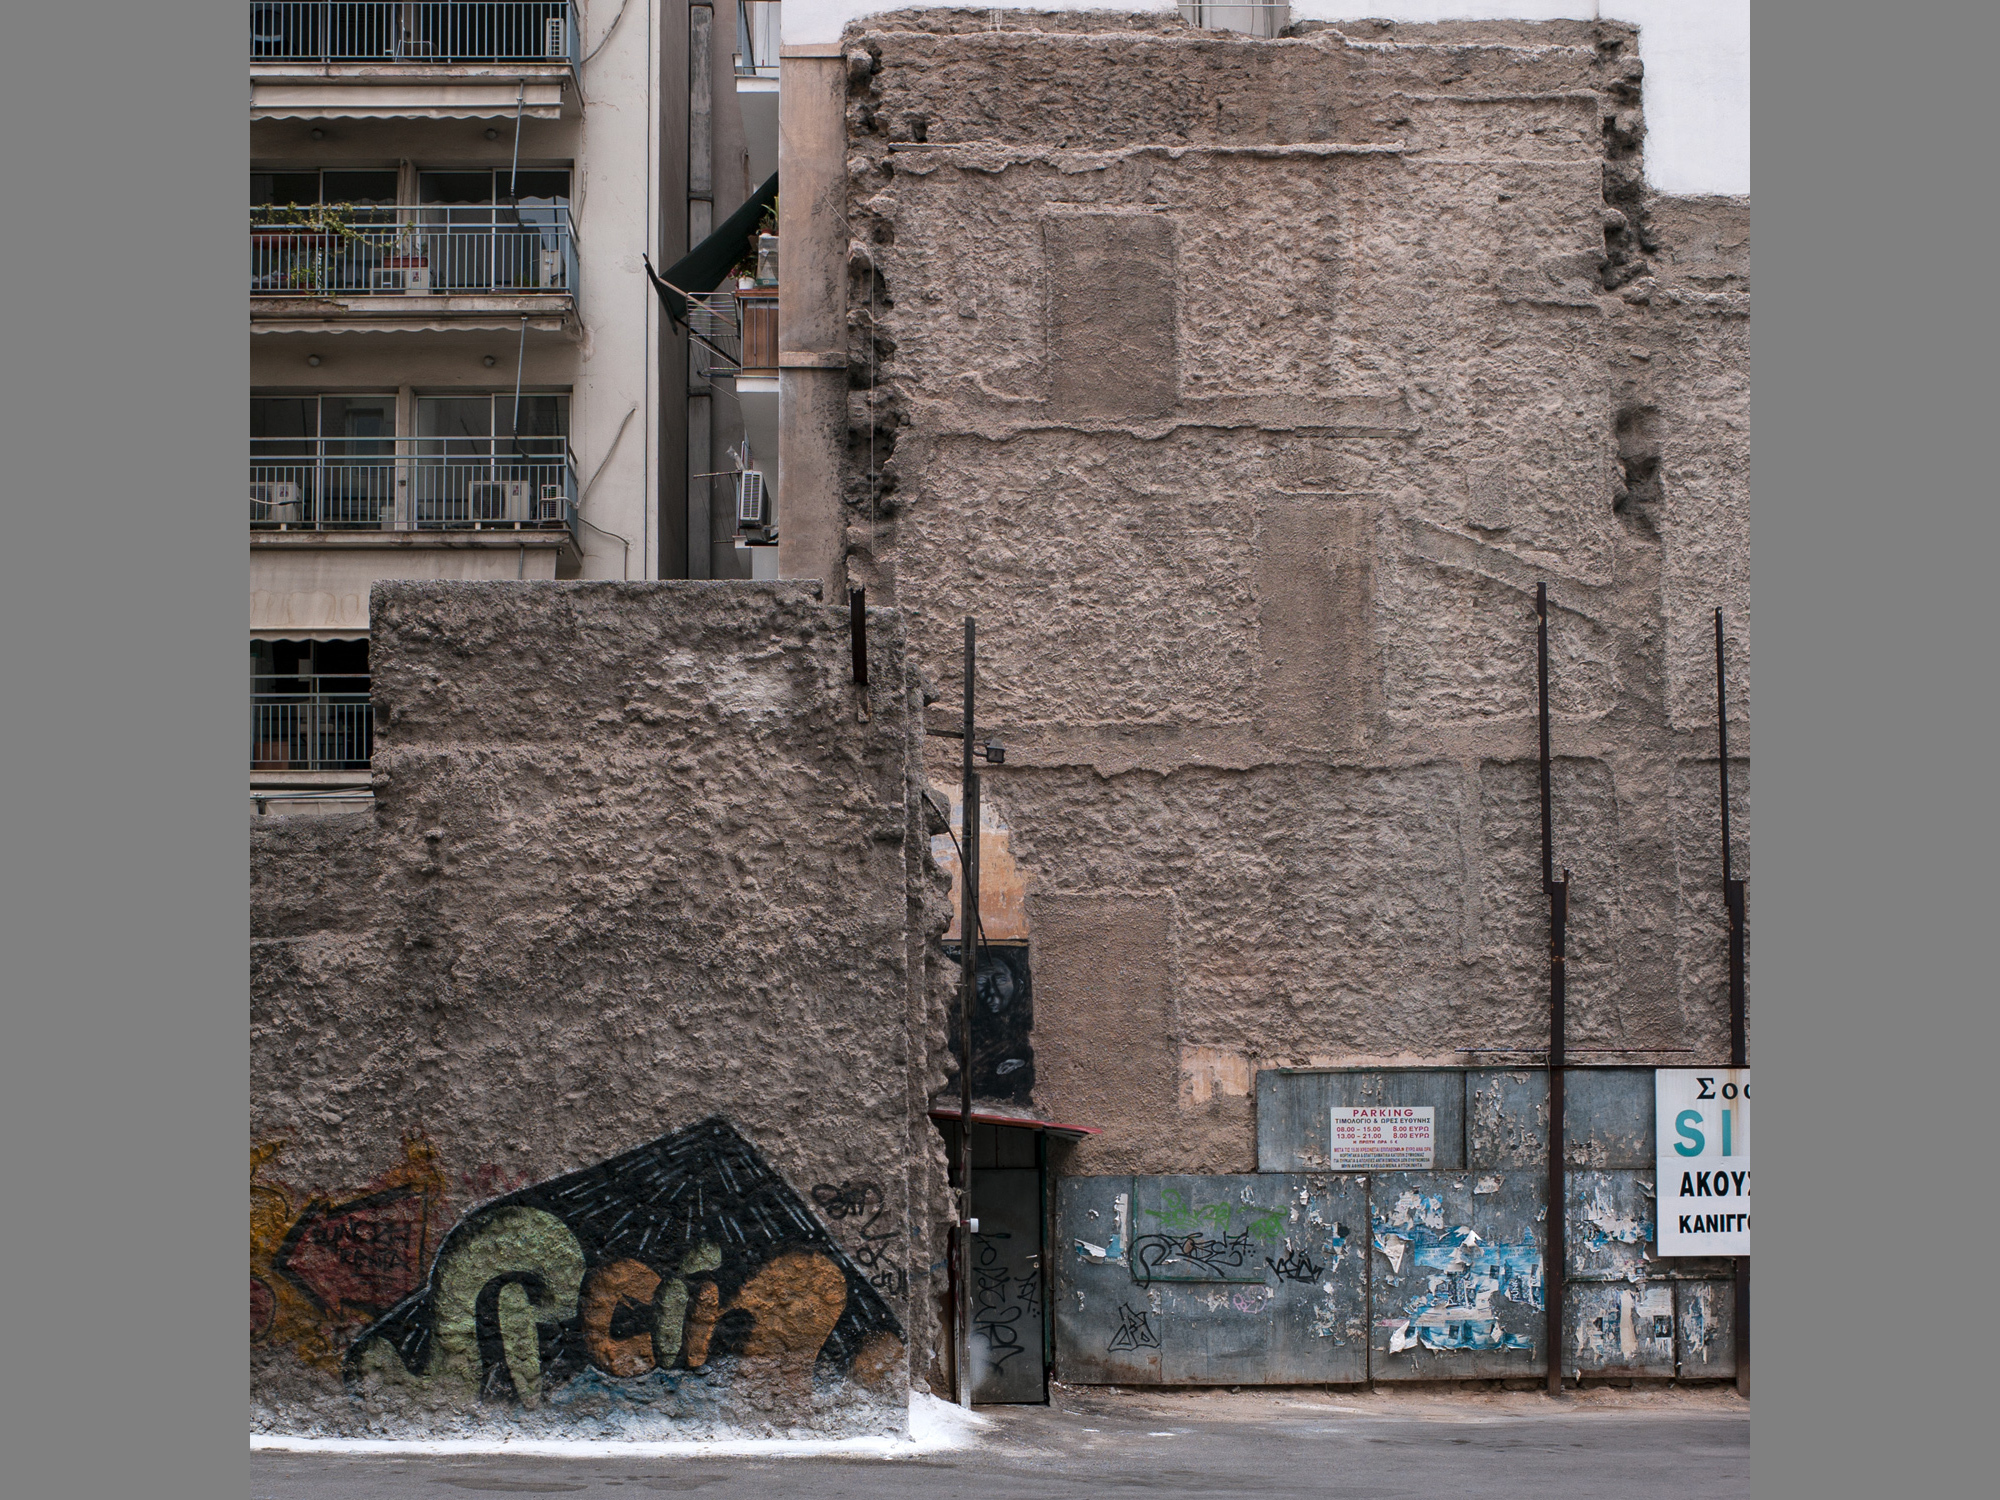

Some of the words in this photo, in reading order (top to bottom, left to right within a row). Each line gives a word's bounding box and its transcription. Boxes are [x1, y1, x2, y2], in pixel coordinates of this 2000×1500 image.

[1352, 1108, 1414, 1117] PARKING
[1679, 1170, 1750, 1197] ΑΚΟΥ
[1678, 1213, 1750, 1234] ΚΑΝΙΓΓ
